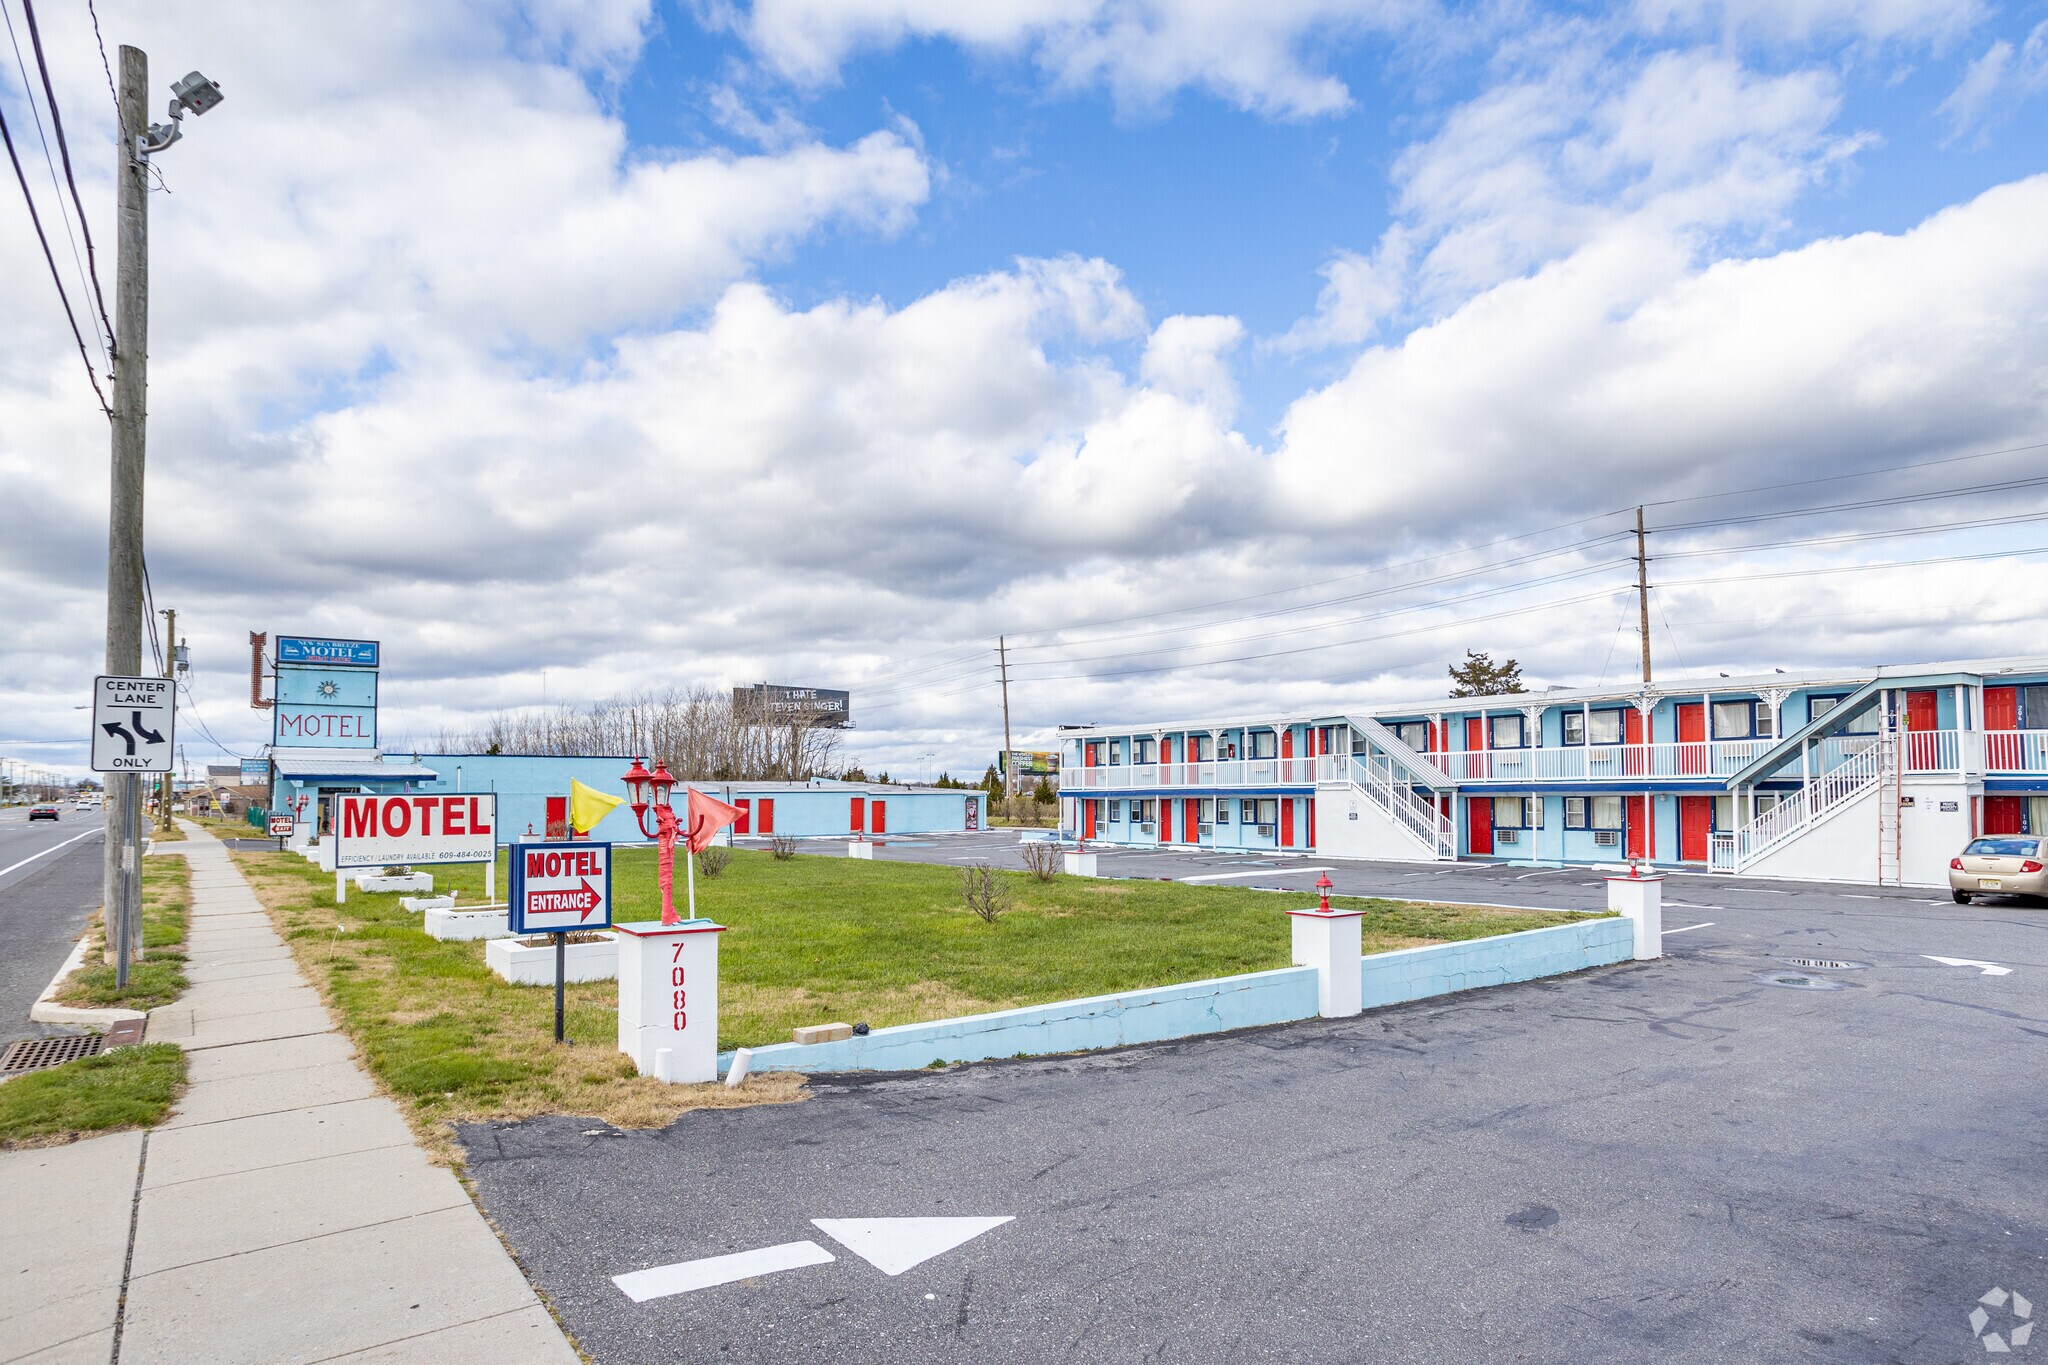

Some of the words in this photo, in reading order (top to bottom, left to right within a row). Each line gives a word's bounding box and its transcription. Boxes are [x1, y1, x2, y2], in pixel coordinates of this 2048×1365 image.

[302, 646, 356, 658] MOTEL
[106, 681, 166, 692] CENTER
[114, 694, 156, 704] LANE
[786, 691, 790, 699] I
[792, 690, 817, 700] HATE
[279, 714, 370, 738] MOTEL
[113, 758, 152, 768] ONLY
[344, 797, 490, 838] MOTEL
[439, 851, 492, 859] 609-484-0025
[527, 852, 602, 878] MOTEL
[530, 892, 592, 910] ENTRANCE
[672, 942, 686, 1031] 7080
